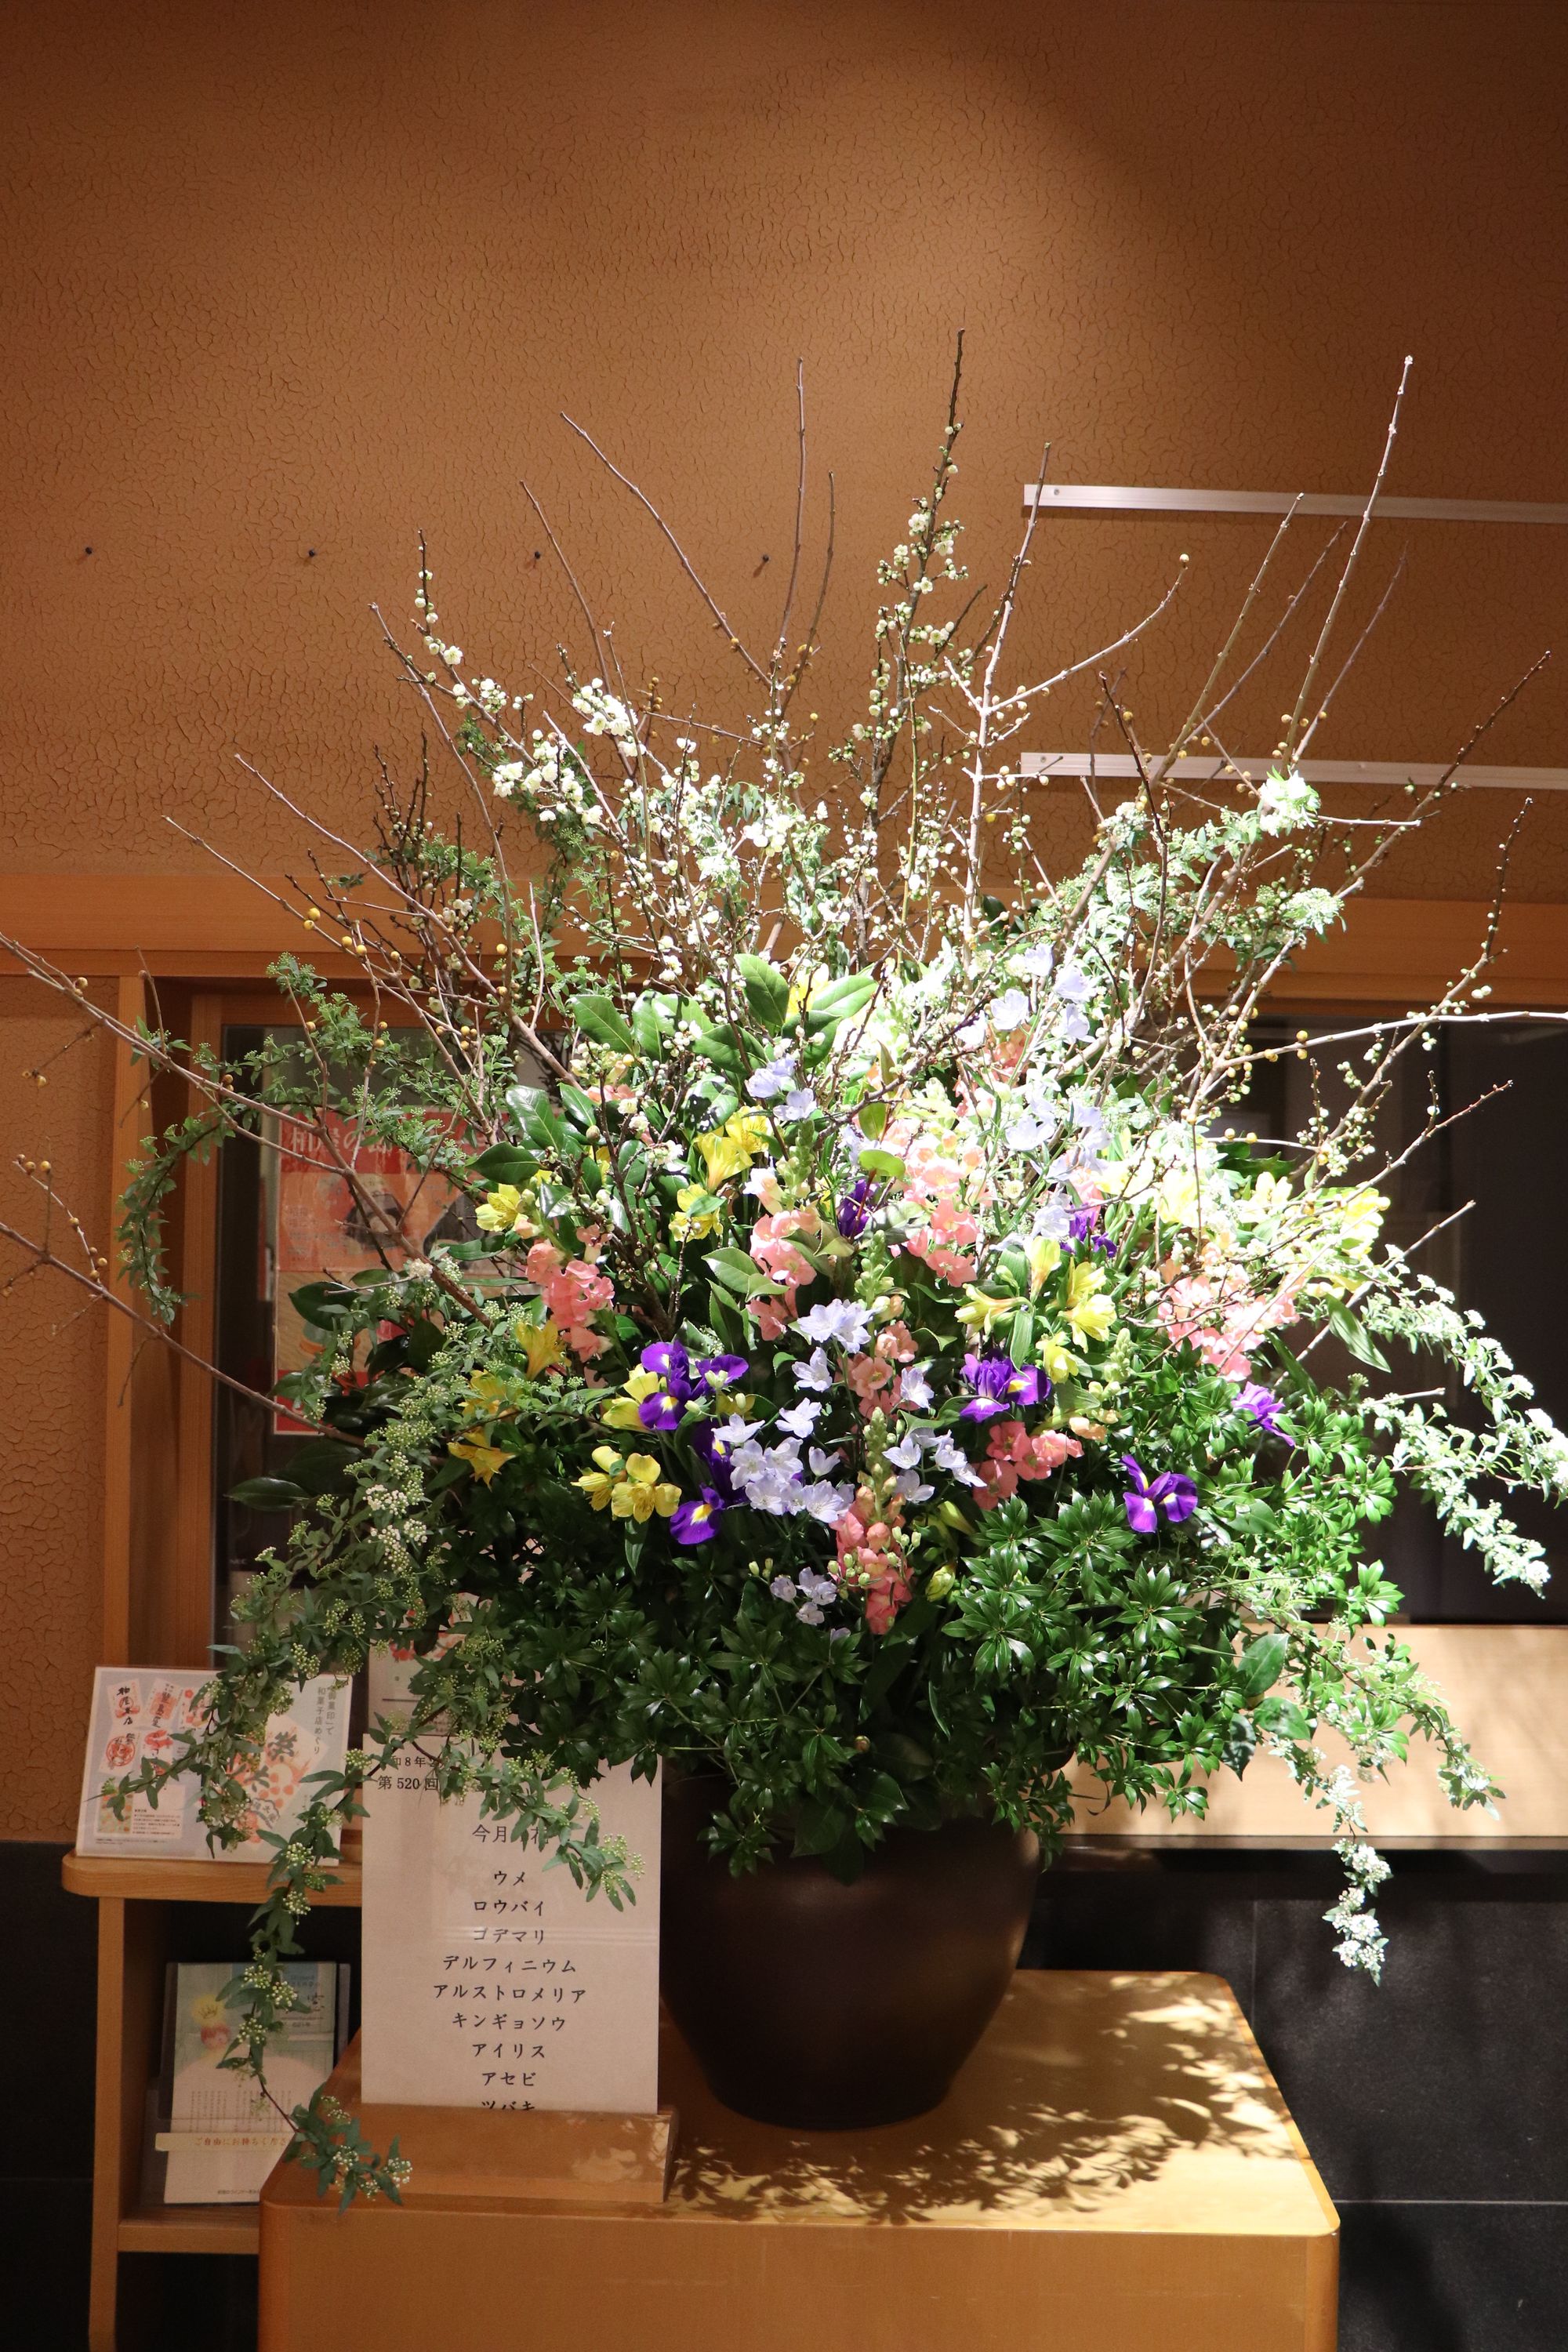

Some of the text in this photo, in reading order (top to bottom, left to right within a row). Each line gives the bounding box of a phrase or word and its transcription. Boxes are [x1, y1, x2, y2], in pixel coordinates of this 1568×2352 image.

[377, 1775, 439, 1791] 第520回
[472, 1823, 549, 1843] 今月花
[493, 1870, 526, 1886] ウメ
[474, 1899, 544, 1917] ロウバイ
[442, 1955, 576, 1973] デルフィニウム
[433, 1984, 586, 2004] アルストロメリア
[452, 2012, 565, 2032] キンギョソウ
[472, 2042, 545, 2060] アイリス
[481, 2071, 536, 2087] アセビ
